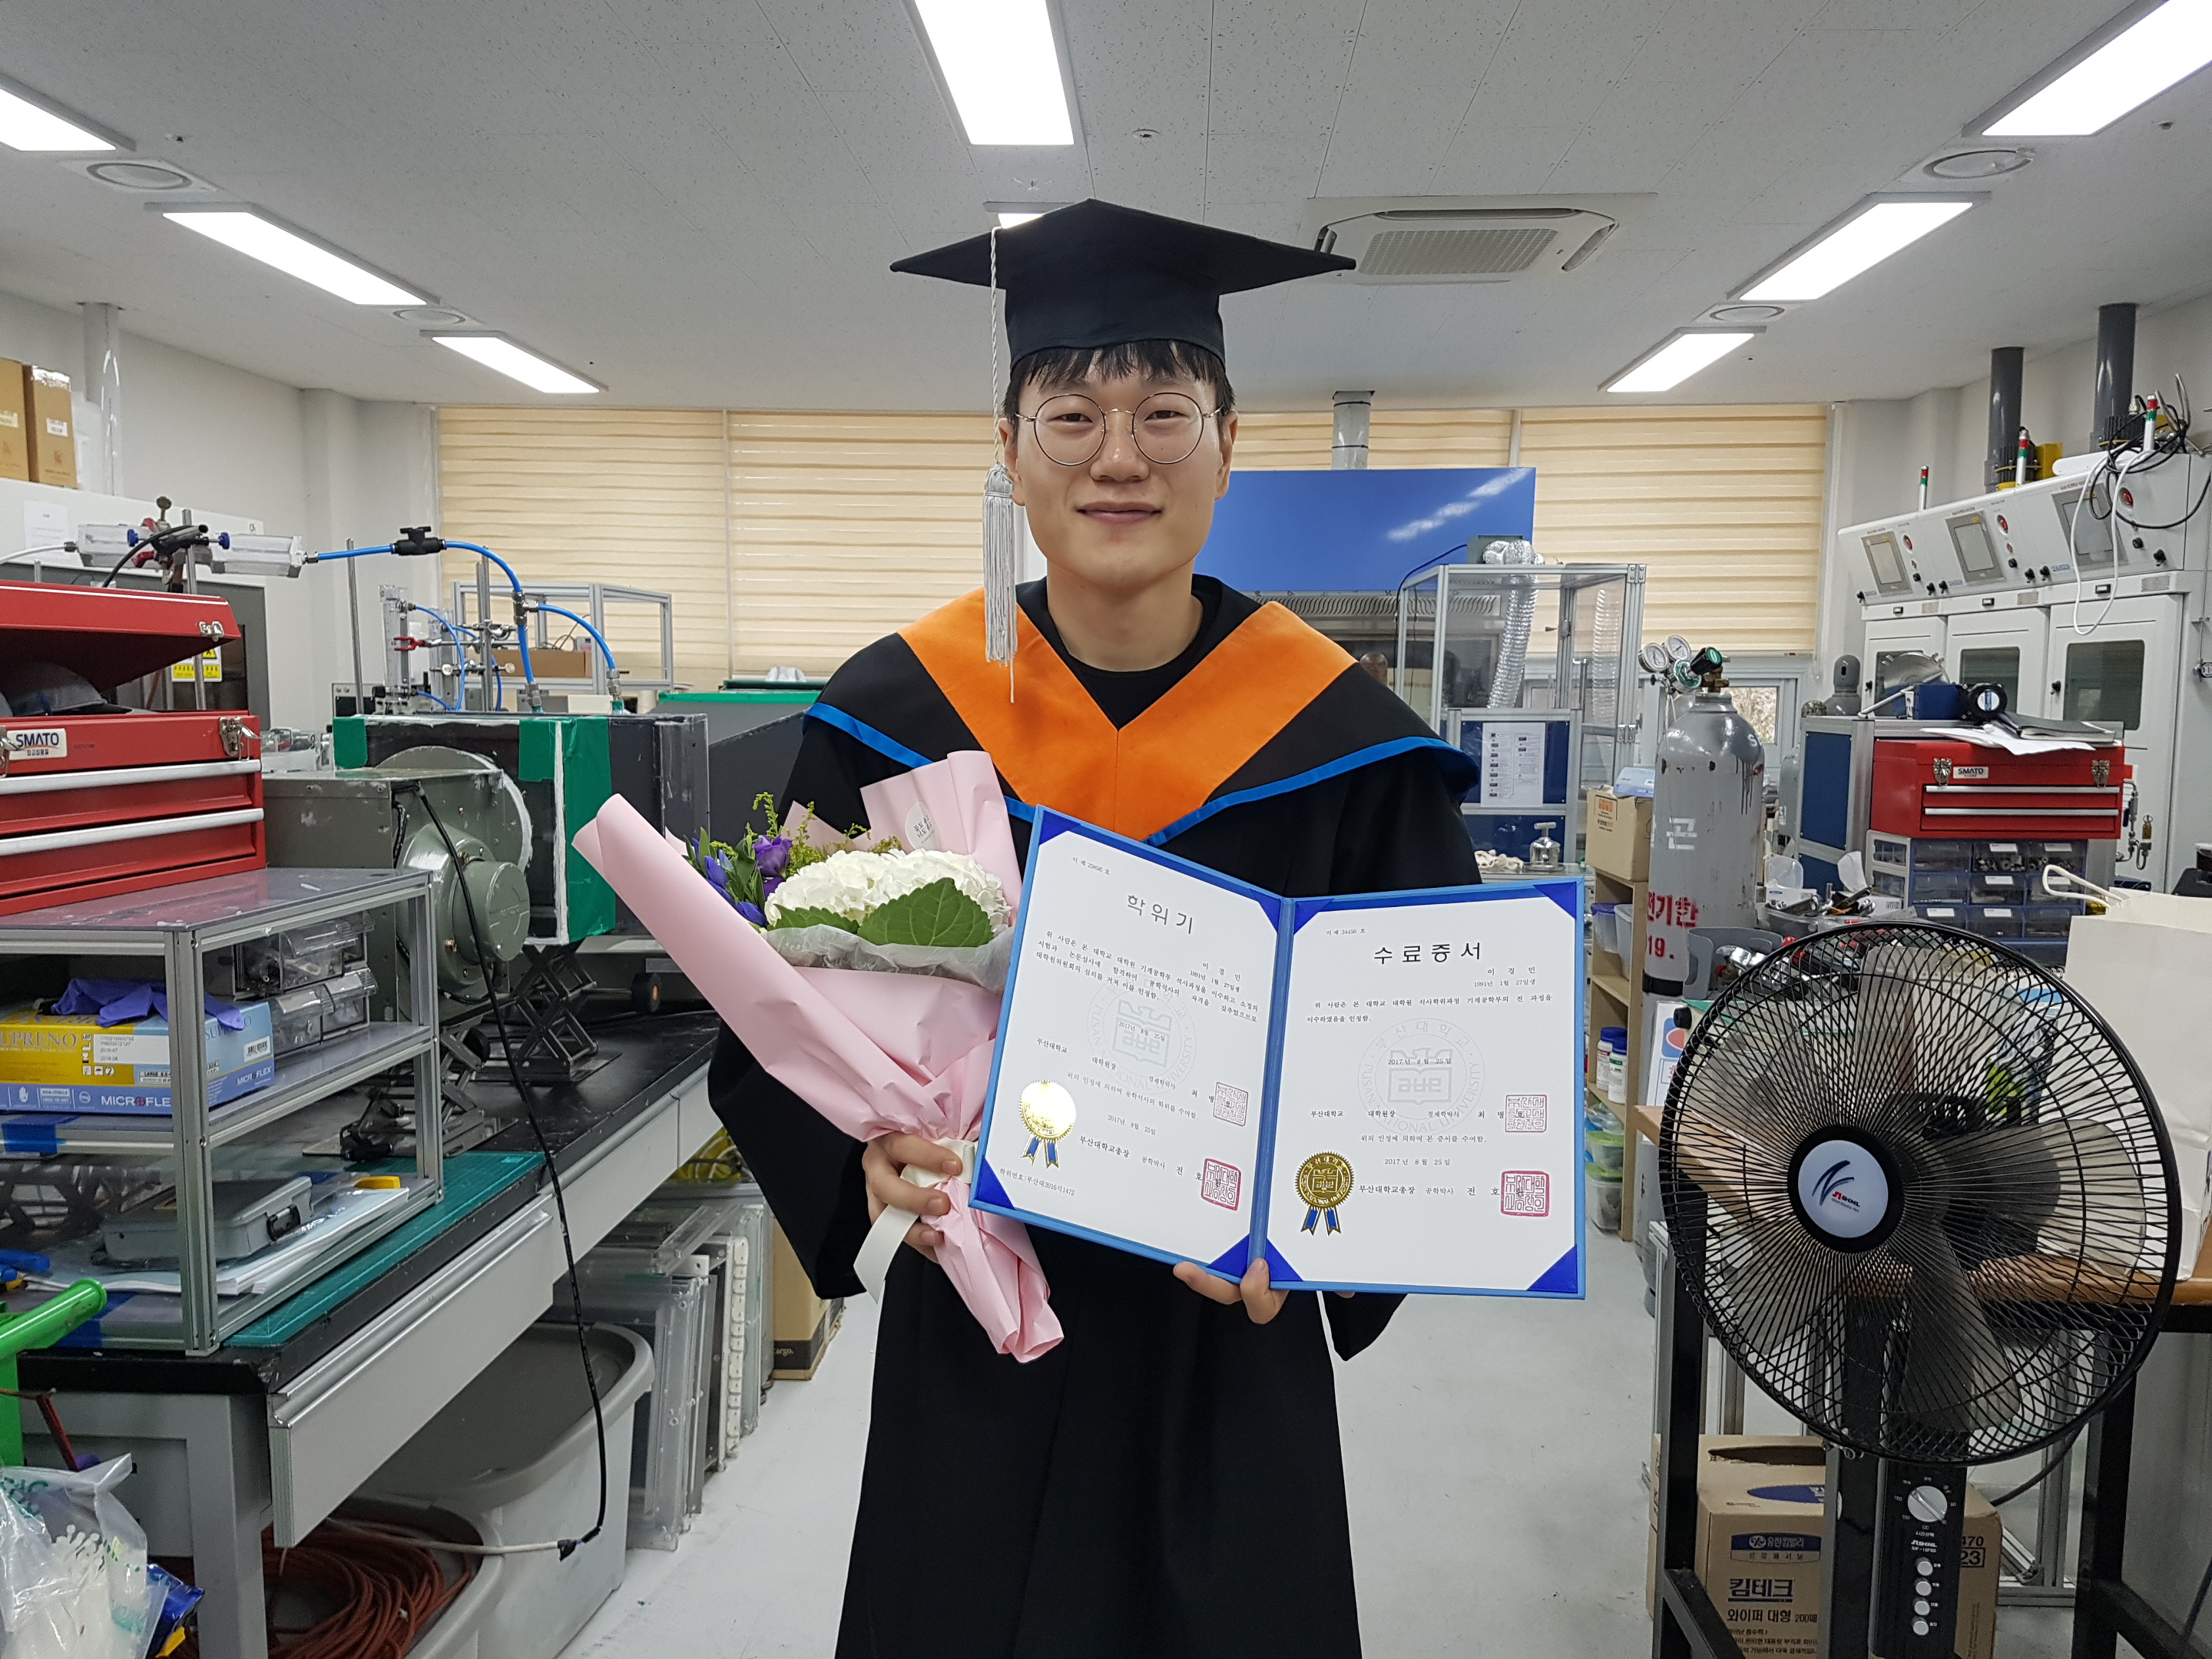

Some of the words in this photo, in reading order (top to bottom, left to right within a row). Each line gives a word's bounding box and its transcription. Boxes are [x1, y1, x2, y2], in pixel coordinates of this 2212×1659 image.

[15, 733, 59, 747] SMATO
[1128, 895, 1193, 934] 학위기
[1036, 952, 1081, 972] 대학원위원회의
[1084, 969, 1103, 981] 심의를
[1122, 982, 1134, 992] 이를
[1038, 940, 1058, 952] 시험과
[1069, 951, 1101, 968] 논문심사에
[1113, 966, 1137, 981] 합격하여
[1149, 979, 1180, 996] 공학석사의
[1190, 995, 1210, 1007] 자격을
[1058, 935, 1077, 947] 사람은
[1093, 949, 1112, 959] 대학교
[1118, 957, 1136, 969] 대학원
[1141, 965, 1171, 981] 기계공학부
[1176, 978, 1207, 994] 석사과정을
[1211, 990, 1236, 1004] 이수하고
[1240, 1001, 1258, 1012] 소정의
[1466, 995, 1509, 1004] 기계공학부의
[0, 1031, 77, 1048] UPRENO
[1037, 1038, 1068, 1053] 부산대학교
[101, 1095, 171, 1107] MICROFLE
[1104, 1083, 1122, 1095] 의하여
[1158, 1101, 1176, 1112] 학위를
[1108, 1114, 1125, 1126] 2017년
[1131, 1121, 1139, 1130] 8월
[1144, 1126, 1156, 1135] 25일
[1378, 1134, 1399, 1143] 인정에
[1080, 1135, 1130, 1158] 부산대학교총장
[1141, 1155, 1166, 1170] 공학박사
[1359, 1184, 1416, 1194] 부산대학교총장
[1426, 1187, 1454, 1195] 공학박사
[775, 1348, 794, 1357] argo.
[1729, 1578, 1793, 1598] 킴테크
[1727, 1609, 1763, 1623] 와이퍼
[1767, 1609, 1791, 1623] 대형
